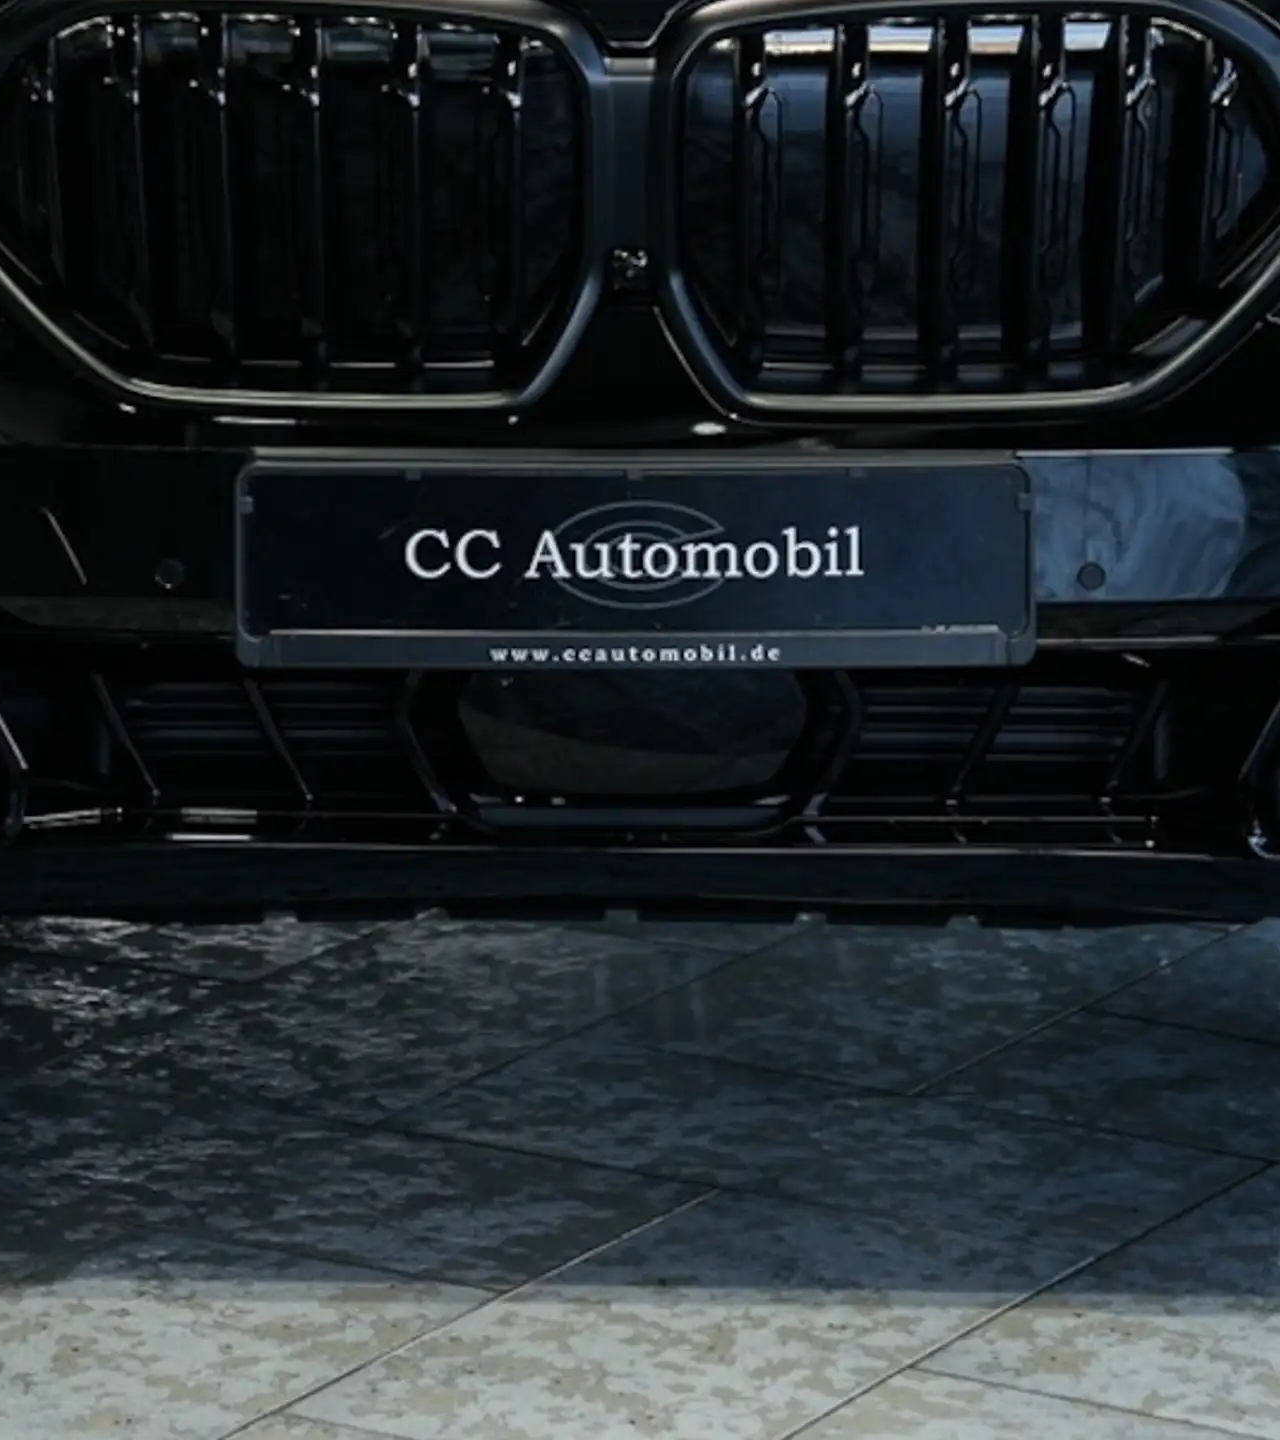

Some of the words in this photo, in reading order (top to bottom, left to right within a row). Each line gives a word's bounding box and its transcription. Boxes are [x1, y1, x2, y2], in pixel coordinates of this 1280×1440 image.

[404, 529, 501, 579] CC
[524, 526, 865, 579] Automobil
[489, 643, 781, 663] www.ccautomobil.de
